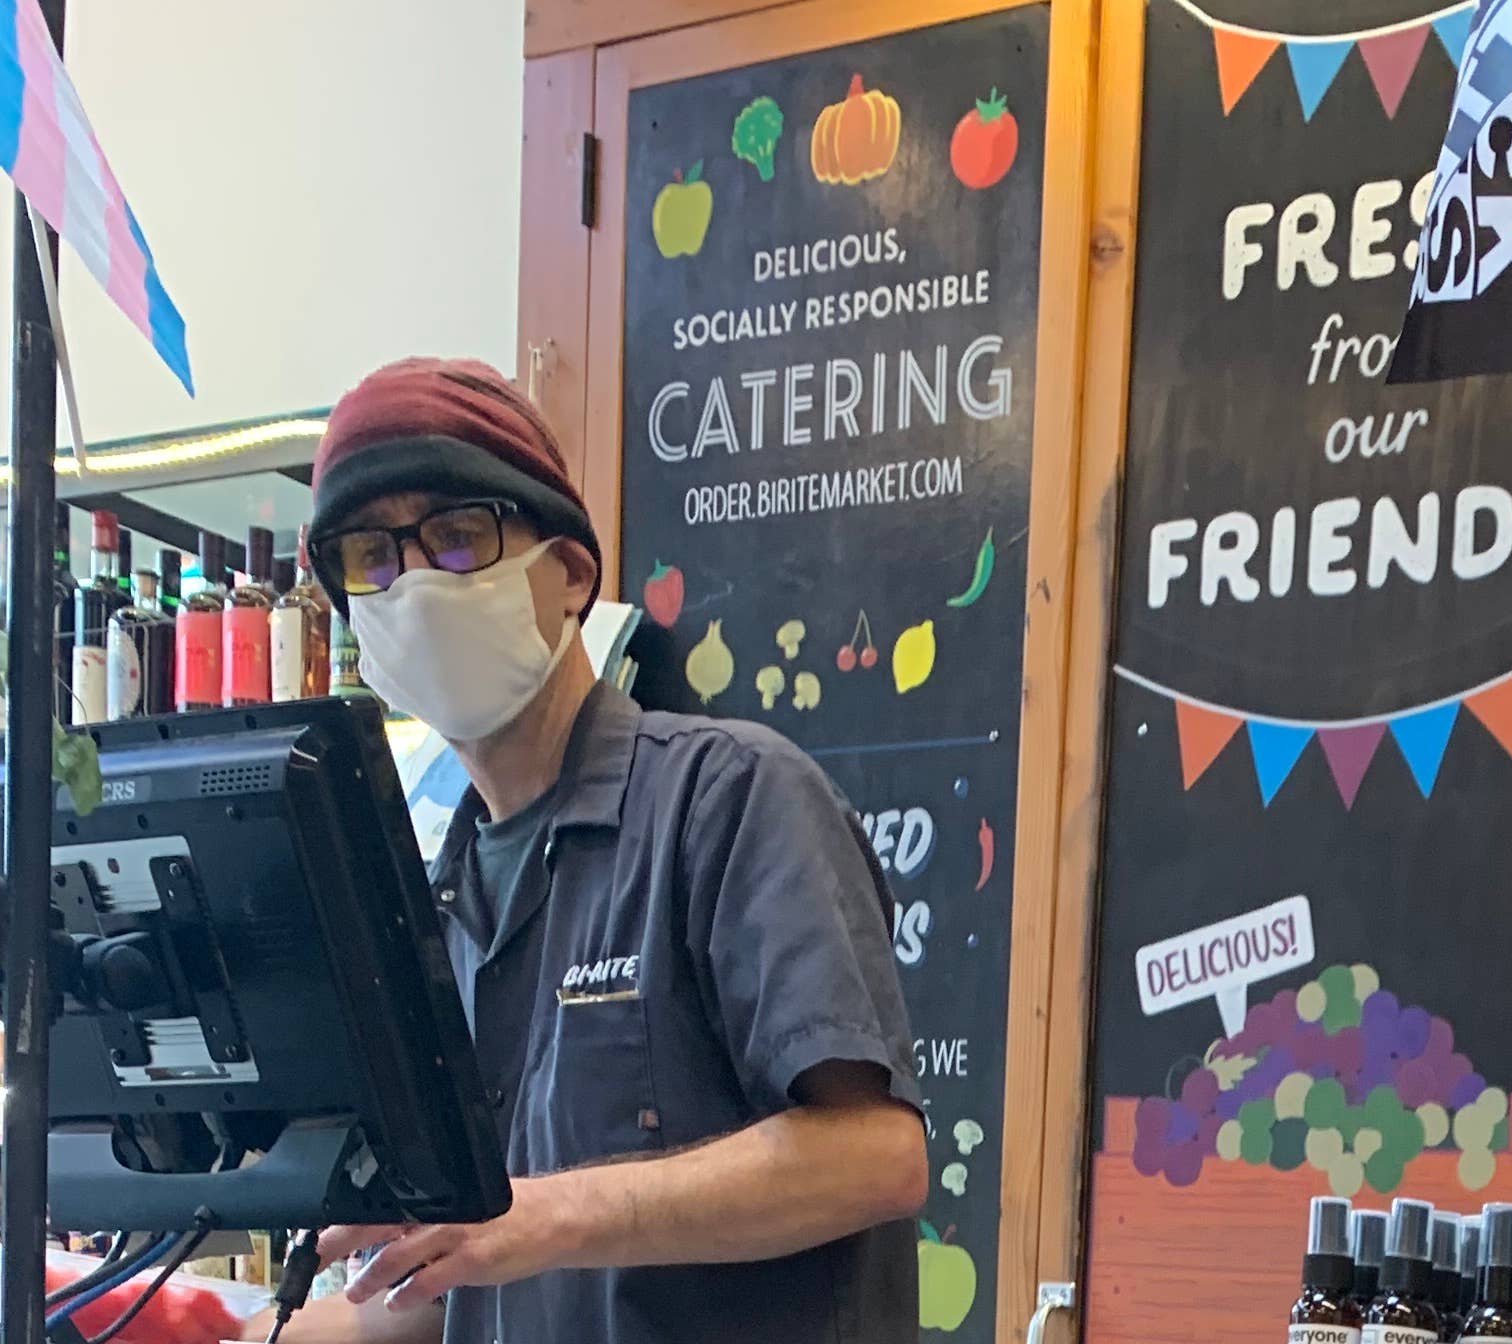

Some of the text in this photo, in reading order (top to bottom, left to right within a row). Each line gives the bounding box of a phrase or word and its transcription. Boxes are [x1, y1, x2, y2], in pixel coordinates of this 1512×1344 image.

[754, 226, 907, 281] DELICIOUS,
[672, 270, 990, 350] SOCIALLY RESPONSIBLE
[1307, 312, 1401, 384] fro
[648, 334, 1012, 462] CATERING
[1324, 408, 1429, 463] our
[684, 456, 962, 525] ORDER.BIRITEMARKET.COM
[1146, 913, 1298, 997] DELICIOUS!
[932, 1040, 968, 1077] WE
